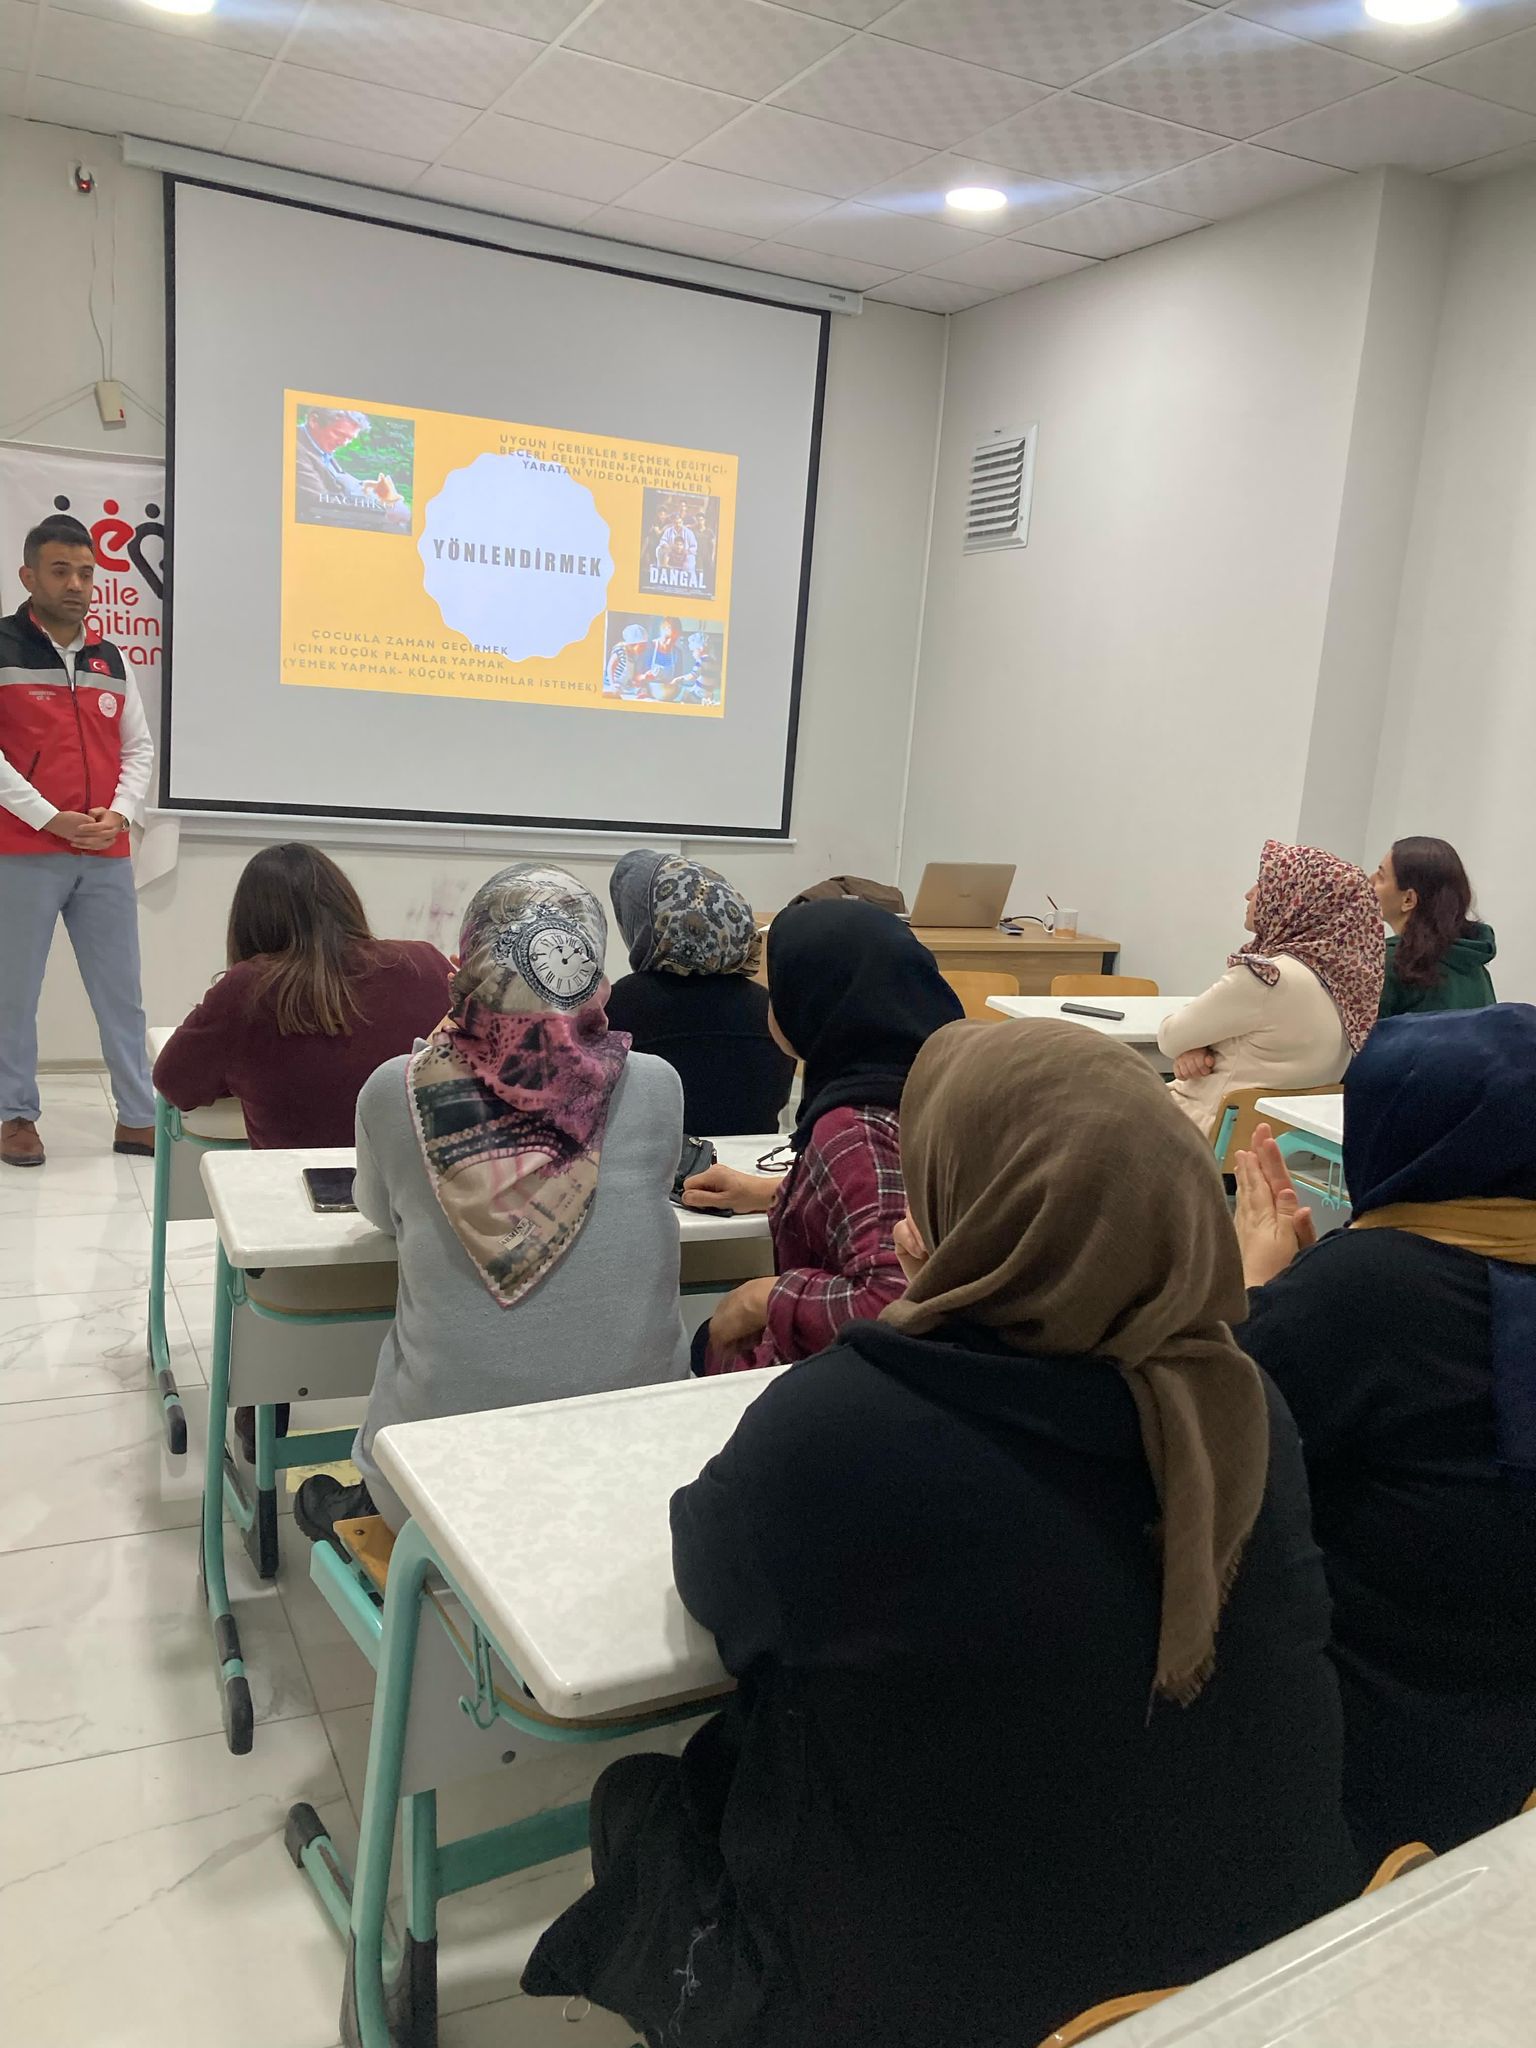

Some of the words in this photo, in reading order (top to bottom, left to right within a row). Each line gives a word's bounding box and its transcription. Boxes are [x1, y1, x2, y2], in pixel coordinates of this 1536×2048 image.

[500, 434, 546, 448] UYGUN
[522, 460, 580, 476] YARATAN
[433, 538, 601, 577] YÖNLENDİRMEK
[649, 565, 706, 588] DANGAL
[85, 608, 160, 638] ğitim
[293, 642, 322, 654] İÇİN
[329, 645, 378, 658] KÜÇÜK
[385, 651, 447, 665] PLANLAR
[452, 656, 504, 669] YAPMAK
[312, 630, 381, 644] ÇOCUKLA
[386, 636, 435, 648] ZAMAN
[441, 641, 508, 655] GEÇİRMEK
[283, 657, 336, 670] (YEMEK
[408, 667, 455, 681] KÜÇÜK
[460, 671, 534, 687] YARDIMLAR
